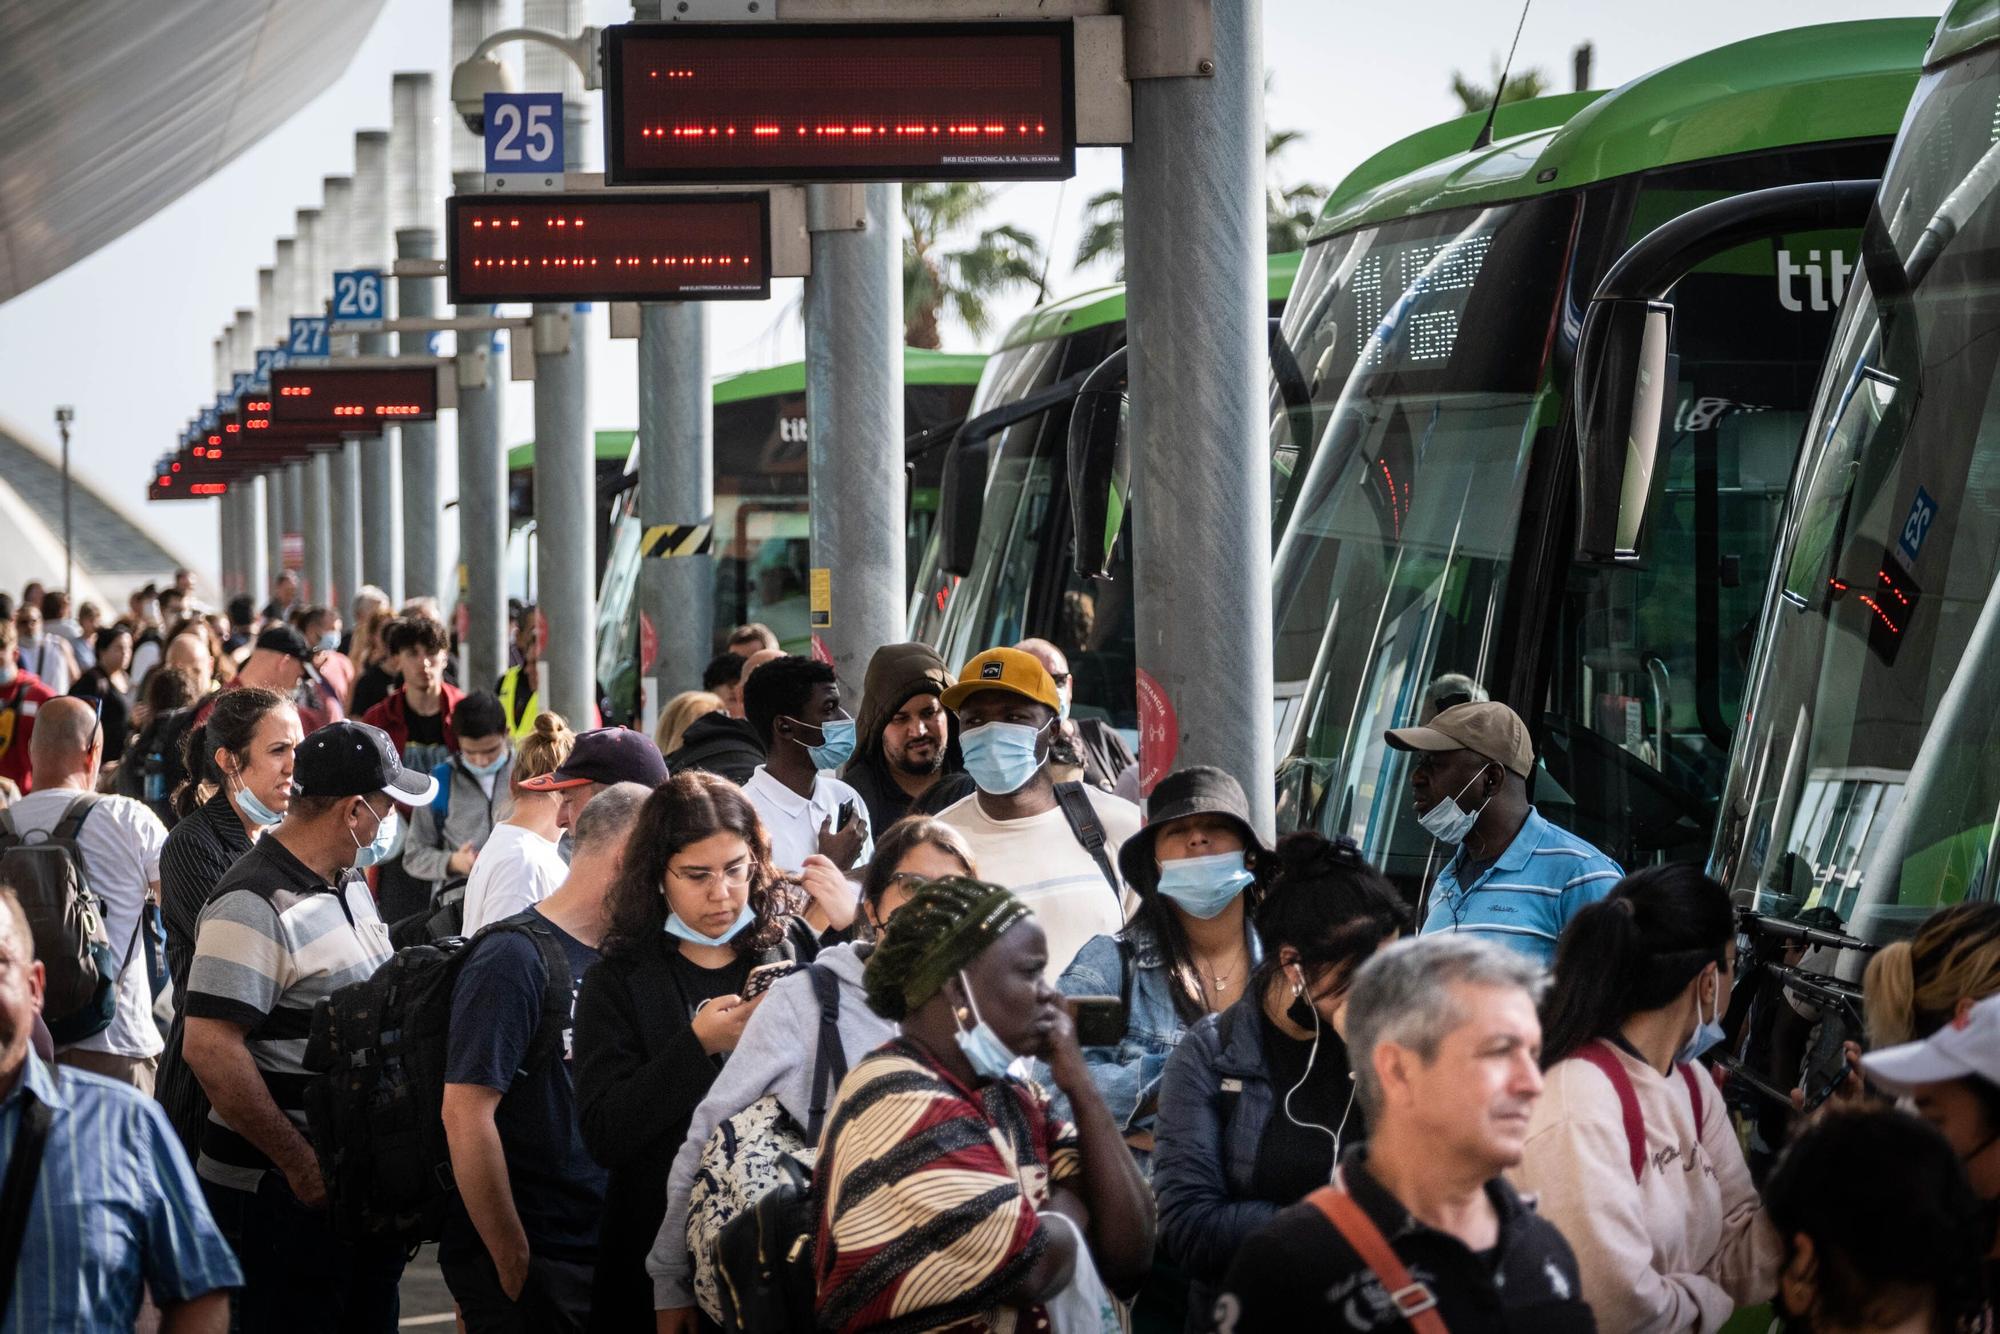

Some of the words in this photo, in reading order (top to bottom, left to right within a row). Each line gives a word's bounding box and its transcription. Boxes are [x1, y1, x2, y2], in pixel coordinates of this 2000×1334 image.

[493, 103, 555, 162] 25
[337, 275, 377, 314] 26
[293, 320, 326, 353] 27
